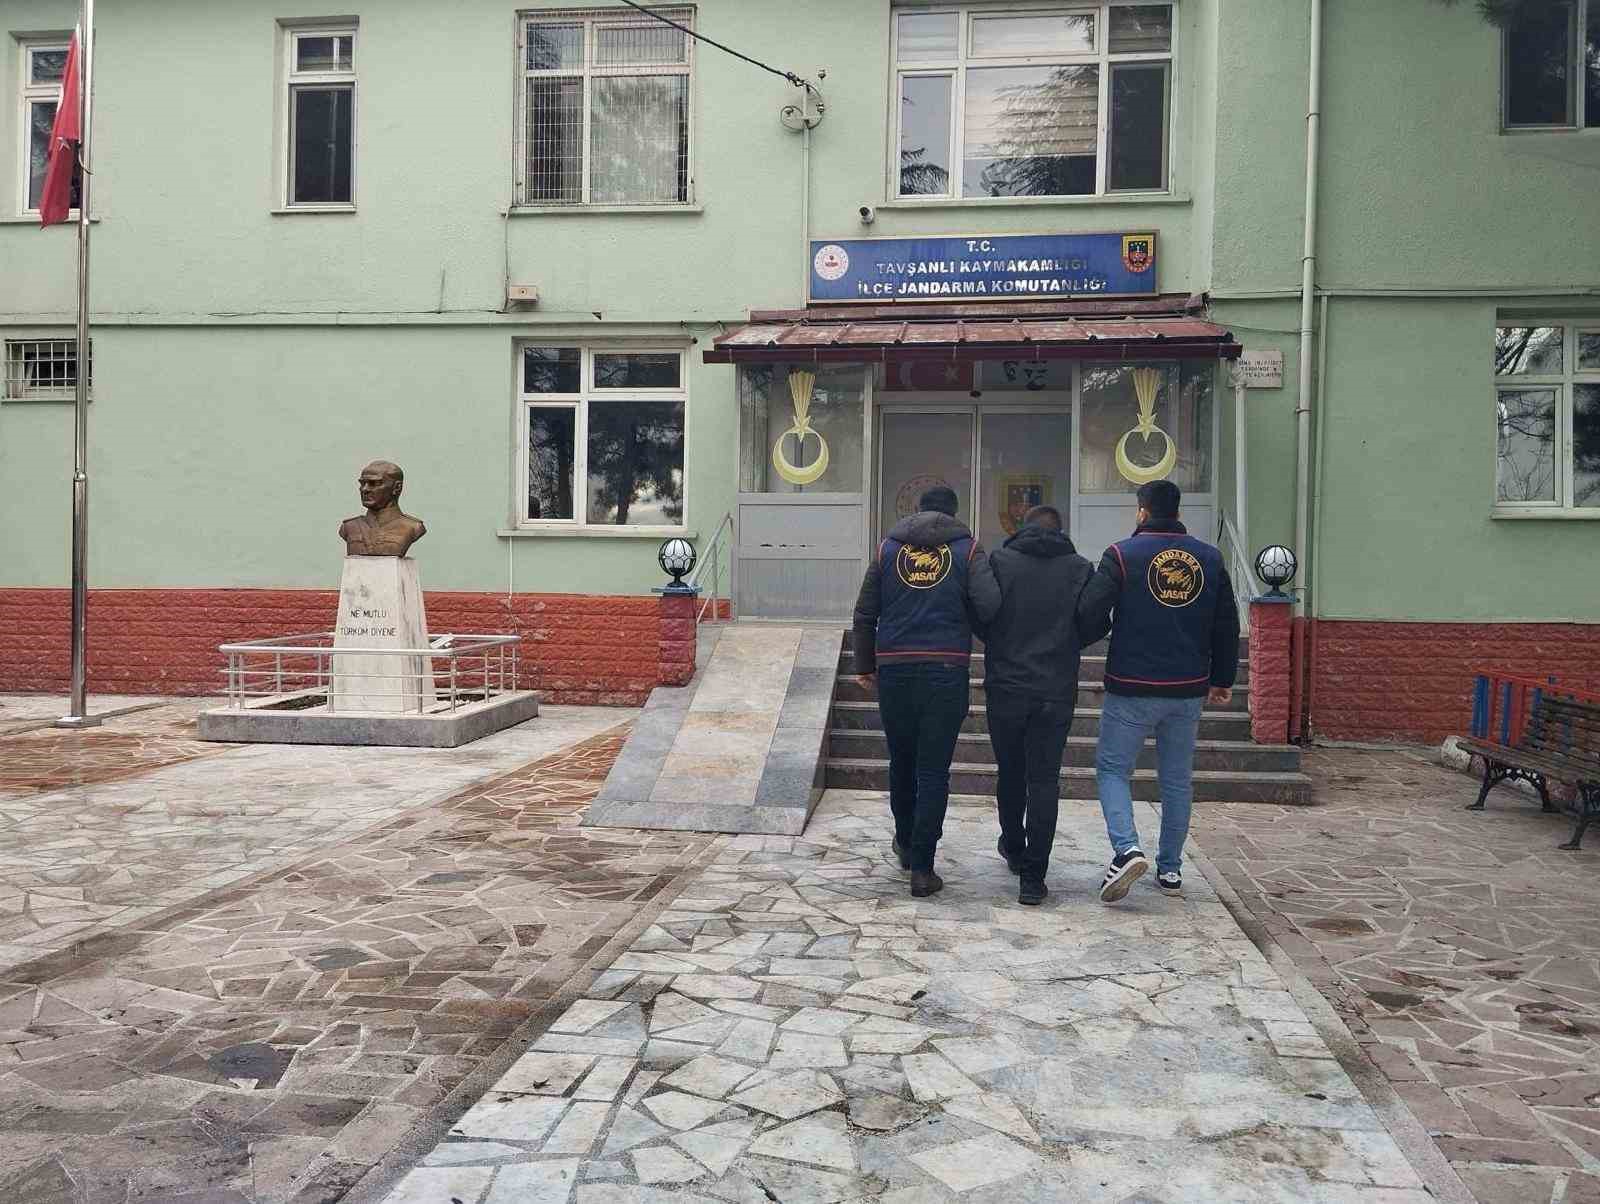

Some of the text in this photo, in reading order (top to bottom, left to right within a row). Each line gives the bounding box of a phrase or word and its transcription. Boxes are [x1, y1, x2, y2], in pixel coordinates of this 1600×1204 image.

[966, 240, 996, 252] T.C.
[876, 261, 955, 276] TAVŞANLI
[898, 280, 986, 294] JANDARMA
[908, 571, 937, 582] JASAT
[1160, 589, 1190, 600] JASAT
[350, 609, 387, 618] NE MUTLU
